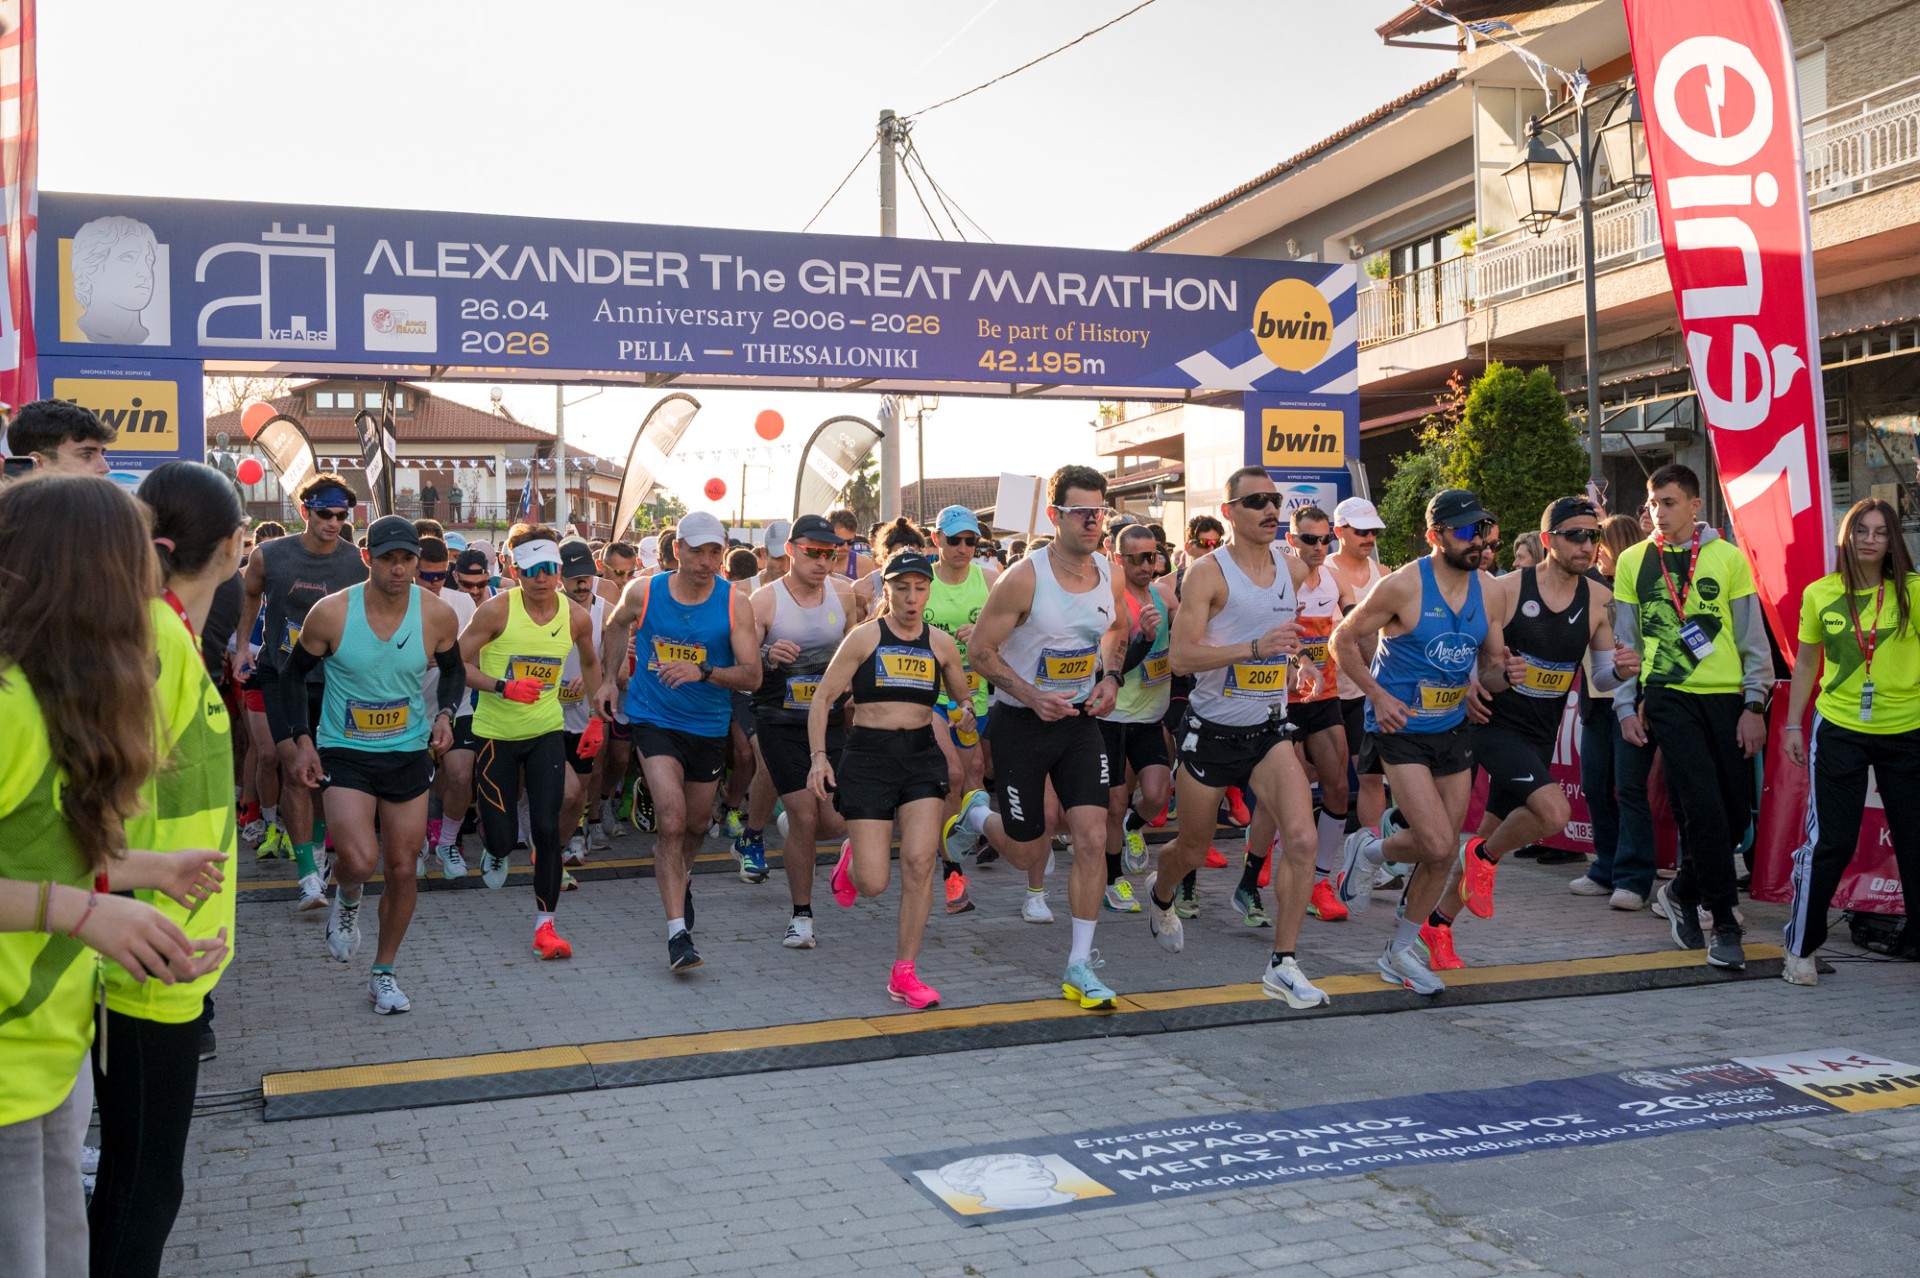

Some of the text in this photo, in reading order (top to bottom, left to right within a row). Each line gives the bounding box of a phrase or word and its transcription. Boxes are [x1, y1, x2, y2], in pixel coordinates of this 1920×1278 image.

[363, 239, 1238, 312] ALEXANDER The GREAT MARATHON
[460, 297, 550, 321] 26.04
[593, 298, 764, 335] Anniversary
[269, 328, 329, 342] YEARS
[976, 317, 1151, 349] Be part of History
[1256, 310, 1331, 342] bwin
[461, 330, 550, 356] 2026
[617, 339, 696, 363] PELLA
[741, 342, 919, 369] THESSALONIKI
[977, 348, 1106, 375] 42.195m
[1266, 424, 1337, 453] bwin
[1699, 601, 1720, 613] bin
[668, 647, 699, 662] 1156
[1308, 646, 1325, 657] 005
[525, 664, 552, 679] 1426
[897, 657, 927, 673] 1778
[1057, 659, 1089, 675] 2072
[1248, 670, 1280, 685] 2067
[1536, 672, 1565, 686] 1001
[367, 711, 400, 726] 1019
[1670, 1062, 1743, 1076] ΔΗΜΟΣ
[1618, 1095, 1711, 1117] 26
[1707, 1093, 1776, 1106] 2026
[1073, 1121, 1243, 1149] Επετειακός
[1091, 1116, 1426, 1165] ΜΑΡΑΘΩΝΙΟΣ
[1116, 1113, 1598, 1181] ΜΕΓΑΣ ΑΛΕΞΑΝΔΡΟΣ
[1151, 1103, 1831, 1195] Αφιερωμένος στον Μαραθωνοδρόμο Στέλιο Κυριακίδη
